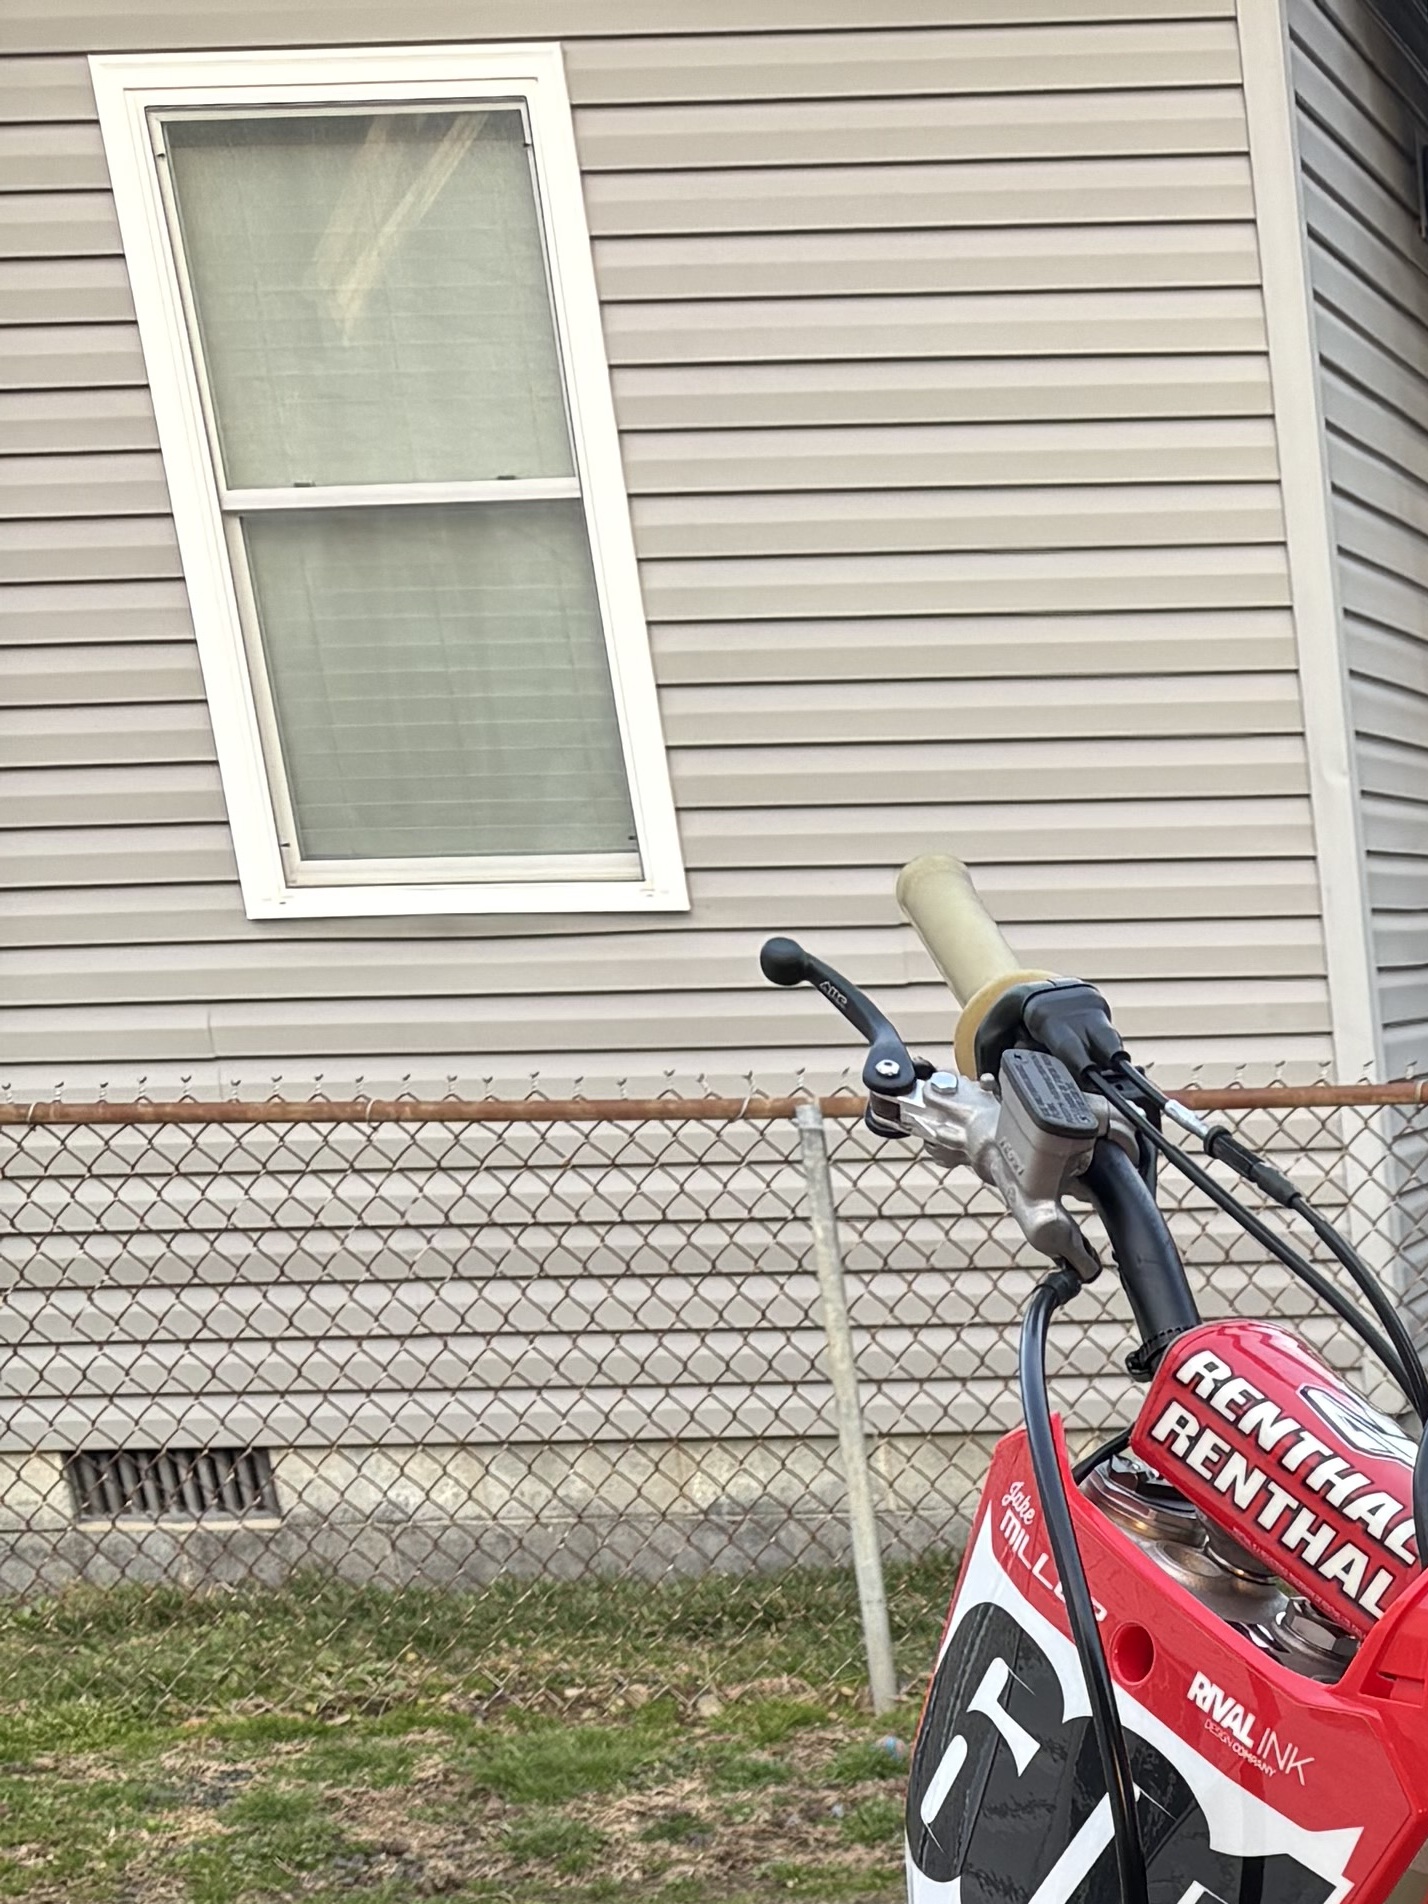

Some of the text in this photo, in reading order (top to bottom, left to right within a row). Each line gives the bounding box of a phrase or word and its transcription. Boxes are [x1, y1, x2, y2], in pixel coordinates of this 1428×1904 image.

[1151, 1401, 1397, 1619] RENTHAL
[1175, 1349, 1418, 1567] RENTHAL
[1186, 1671, 1315, 1786] RIVAL INK
